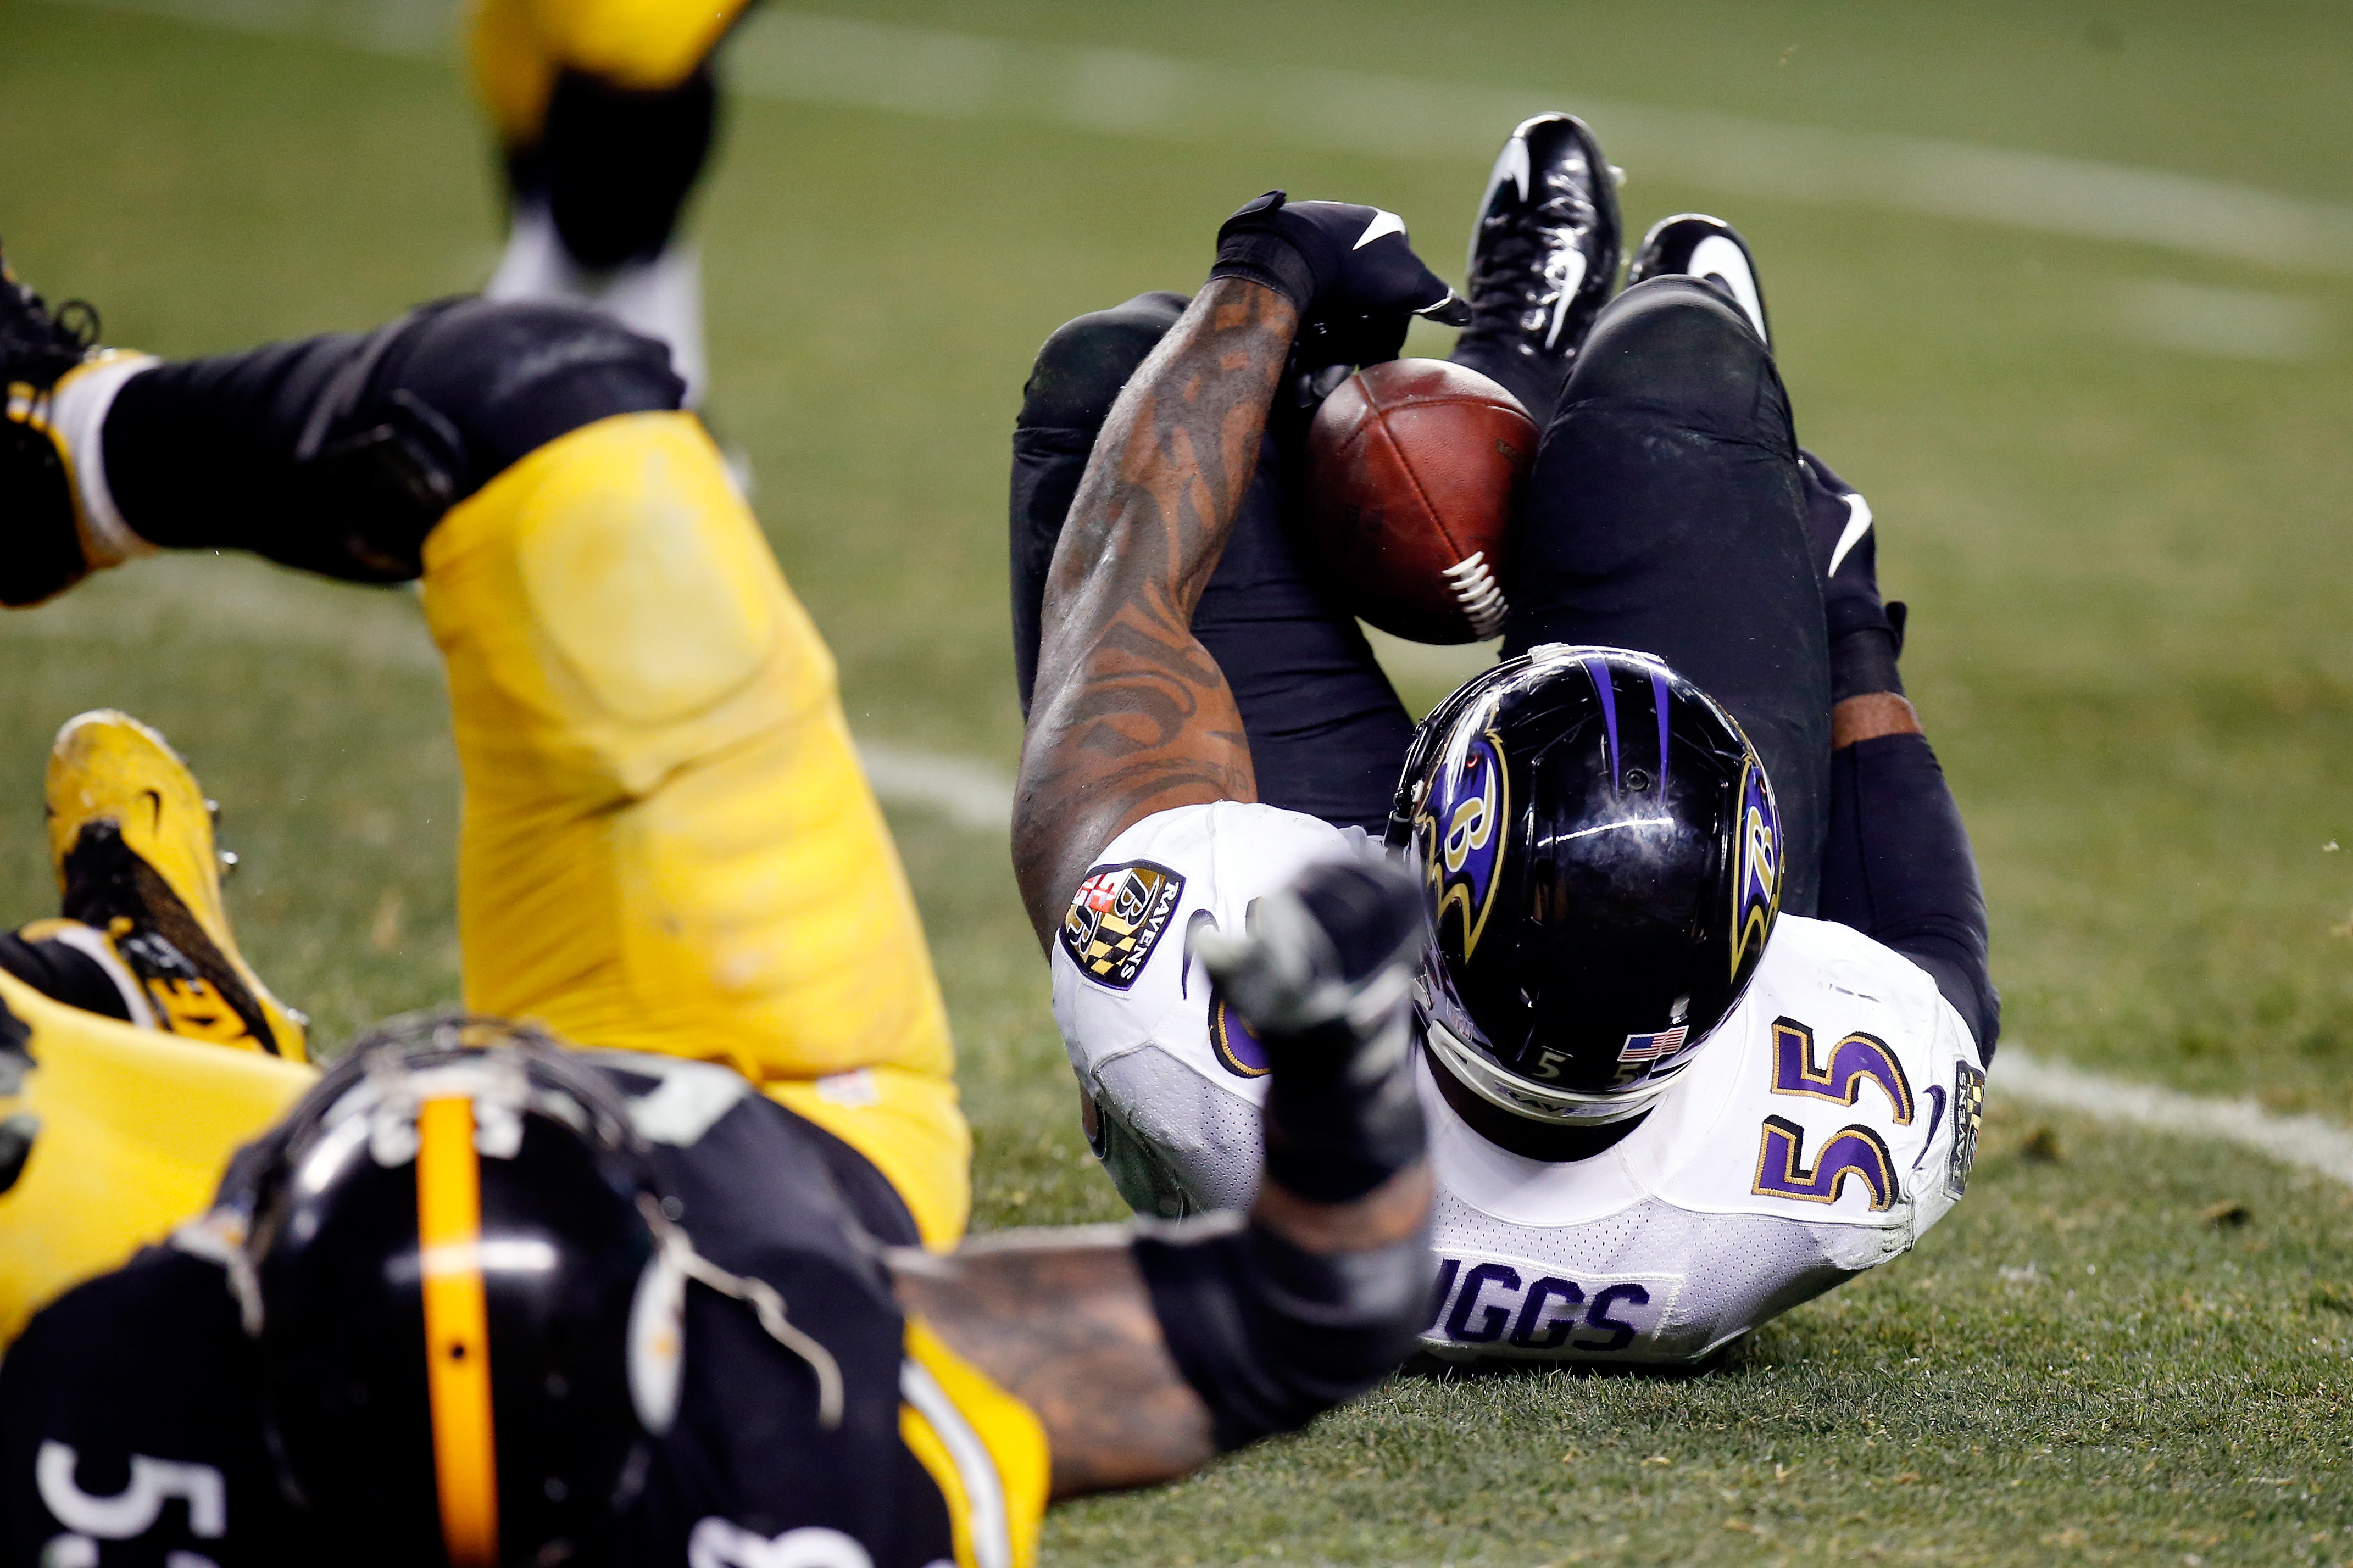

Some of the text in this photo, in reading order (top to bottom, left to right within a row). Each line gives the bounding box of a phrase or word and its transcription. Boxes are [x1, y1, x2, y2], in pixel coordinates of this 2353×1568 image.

[1443, 758, 1497, 873] B
[1120, 881, 1180, 980] RAVENS
[1751, 1015, 1915, 1212] 55
[1422, 1258, 1651, 1352] GGS
[34, 1438, 230, 1568] 5
